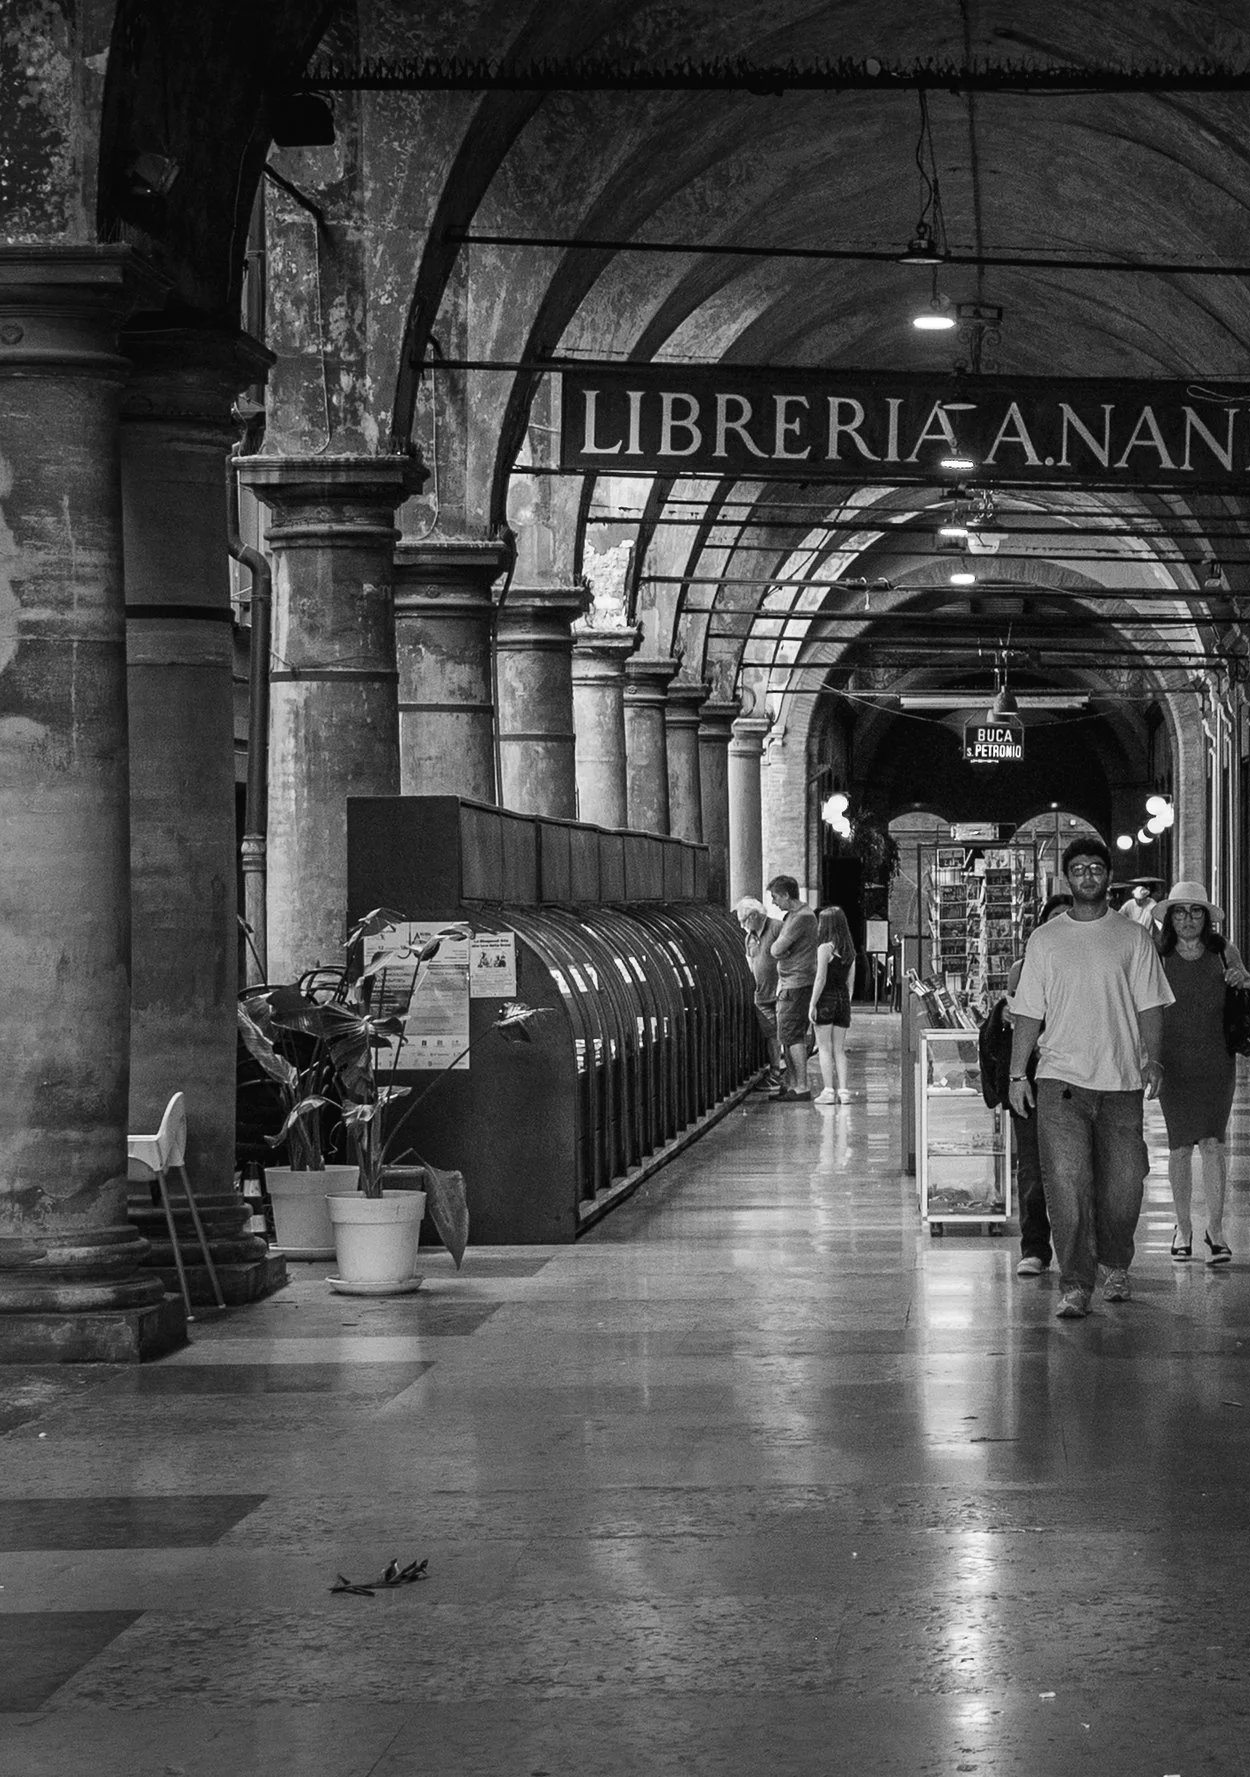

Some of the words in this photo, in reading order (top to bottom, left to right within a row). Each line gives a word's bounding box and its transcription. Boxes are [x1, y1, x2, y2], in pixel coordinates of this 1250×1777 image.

[580, 390, 961, 463] LIBRERIA
[977, 728, 1013, 742] BUCA
[975, 744, 1022, 758] PETRONIO
